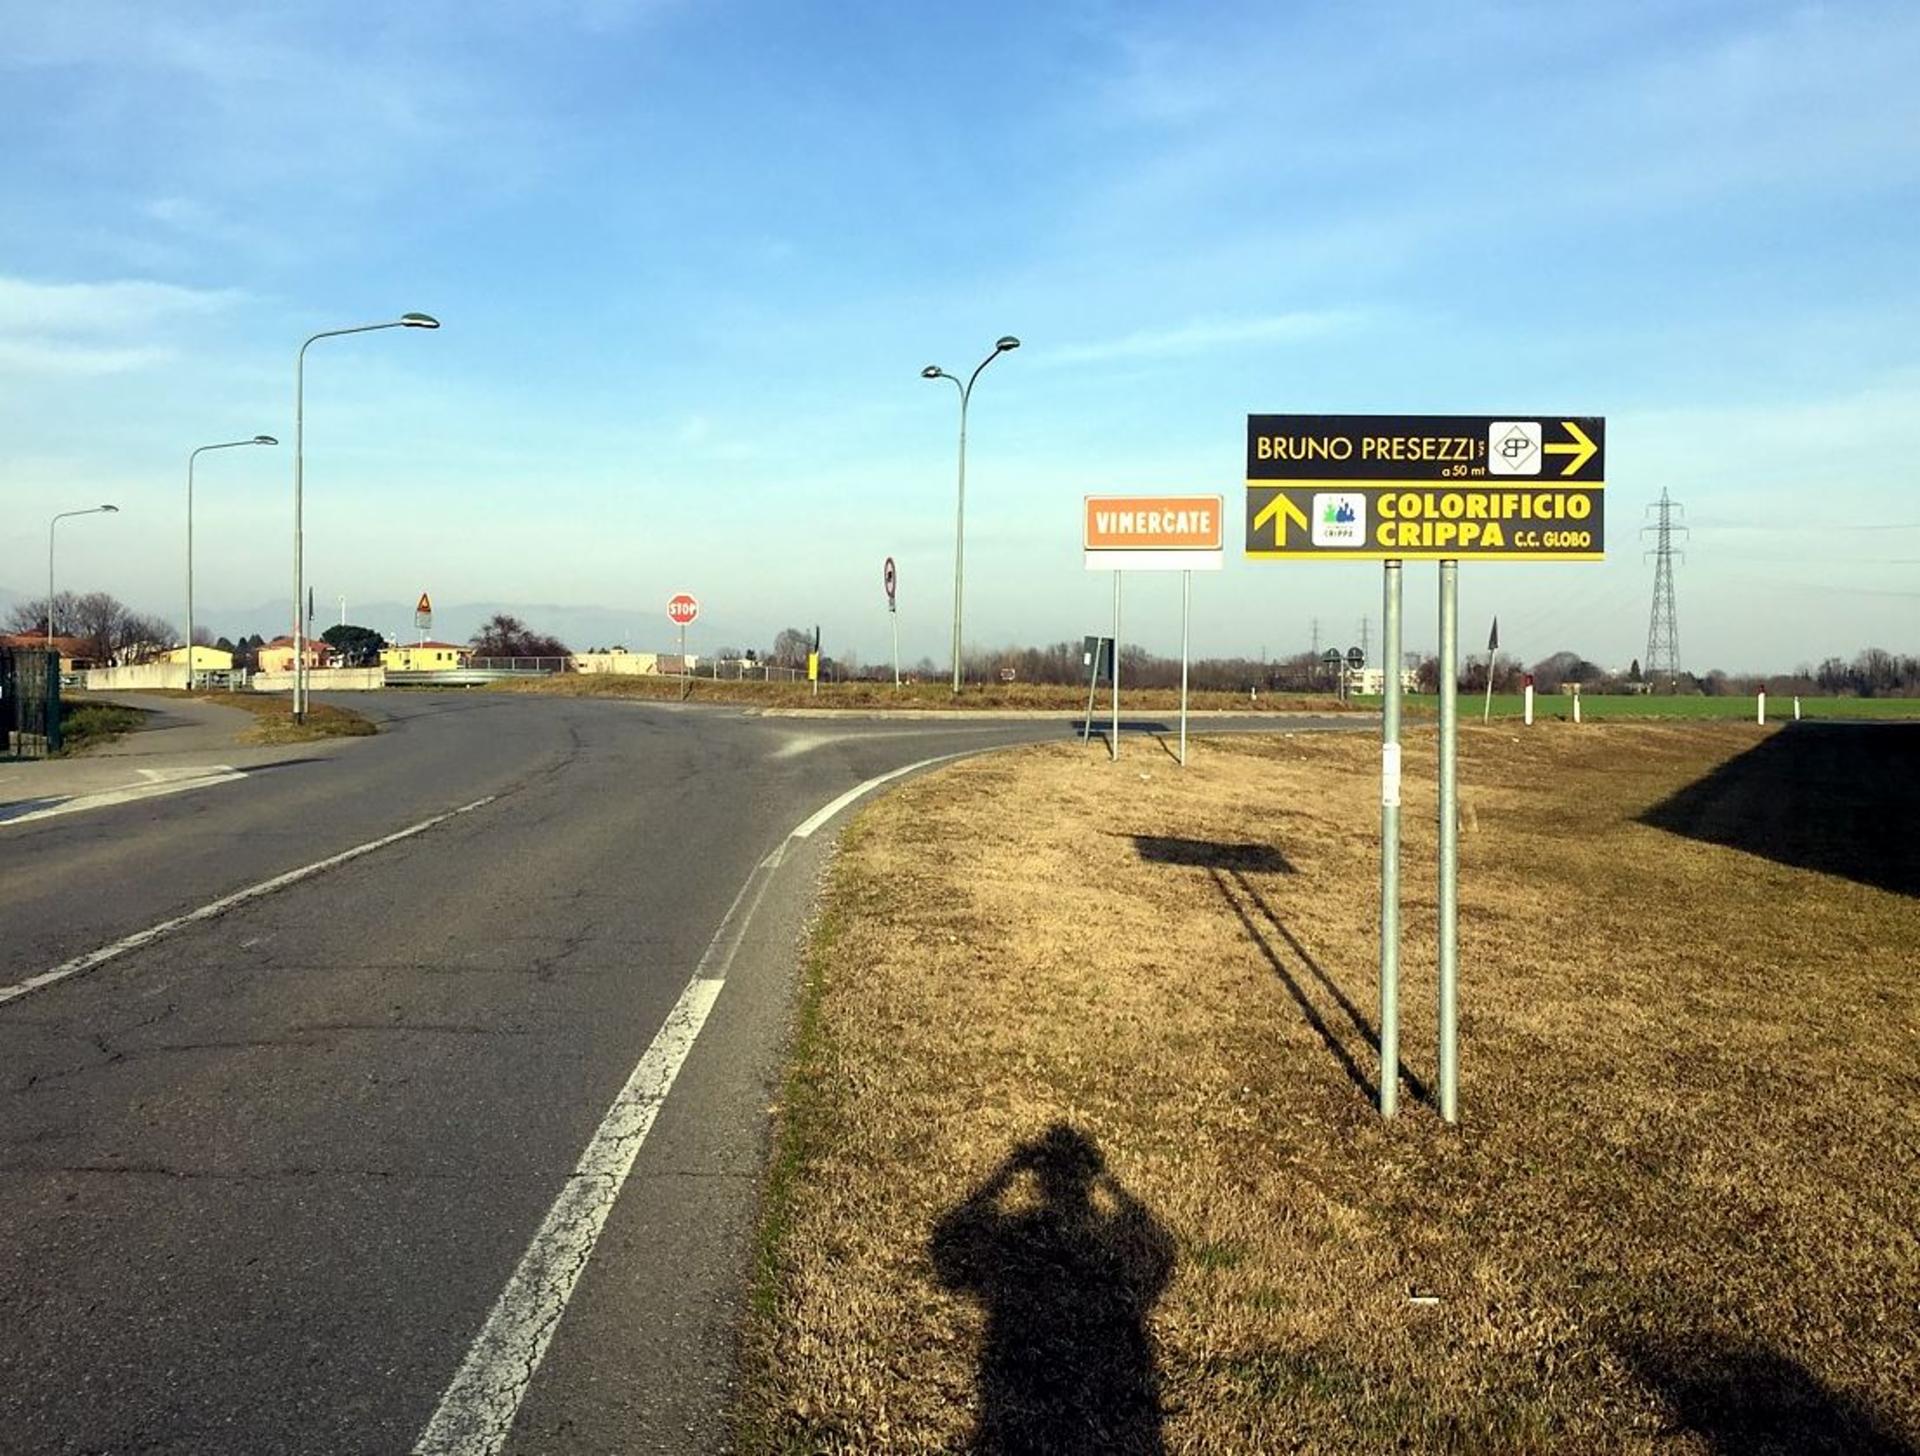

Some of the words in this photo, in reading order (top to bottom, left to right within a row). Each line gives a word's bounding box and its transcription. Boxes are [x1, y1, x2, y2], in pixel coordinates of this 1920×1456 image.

[1257, 437, 1353, 460] BRUNO
[1362, 437, 1475, 460] PRESEZZI
[1441, 468, 1451, 477] a
[1452, 465, 1468, 477] 50
[1471, 467, 1485, 476] mt
[1377, 493, 1591, 519] COLORIFICIO
[1095, 511, 1212, 534] VIMERCATE
[1376, 521, 1505, 547] CRIPPA
[1514, 531, 1540, 547] C.C.
[1543, 531, 1591, 547] GLOBO
[670, 602, 696, 615] STOP
